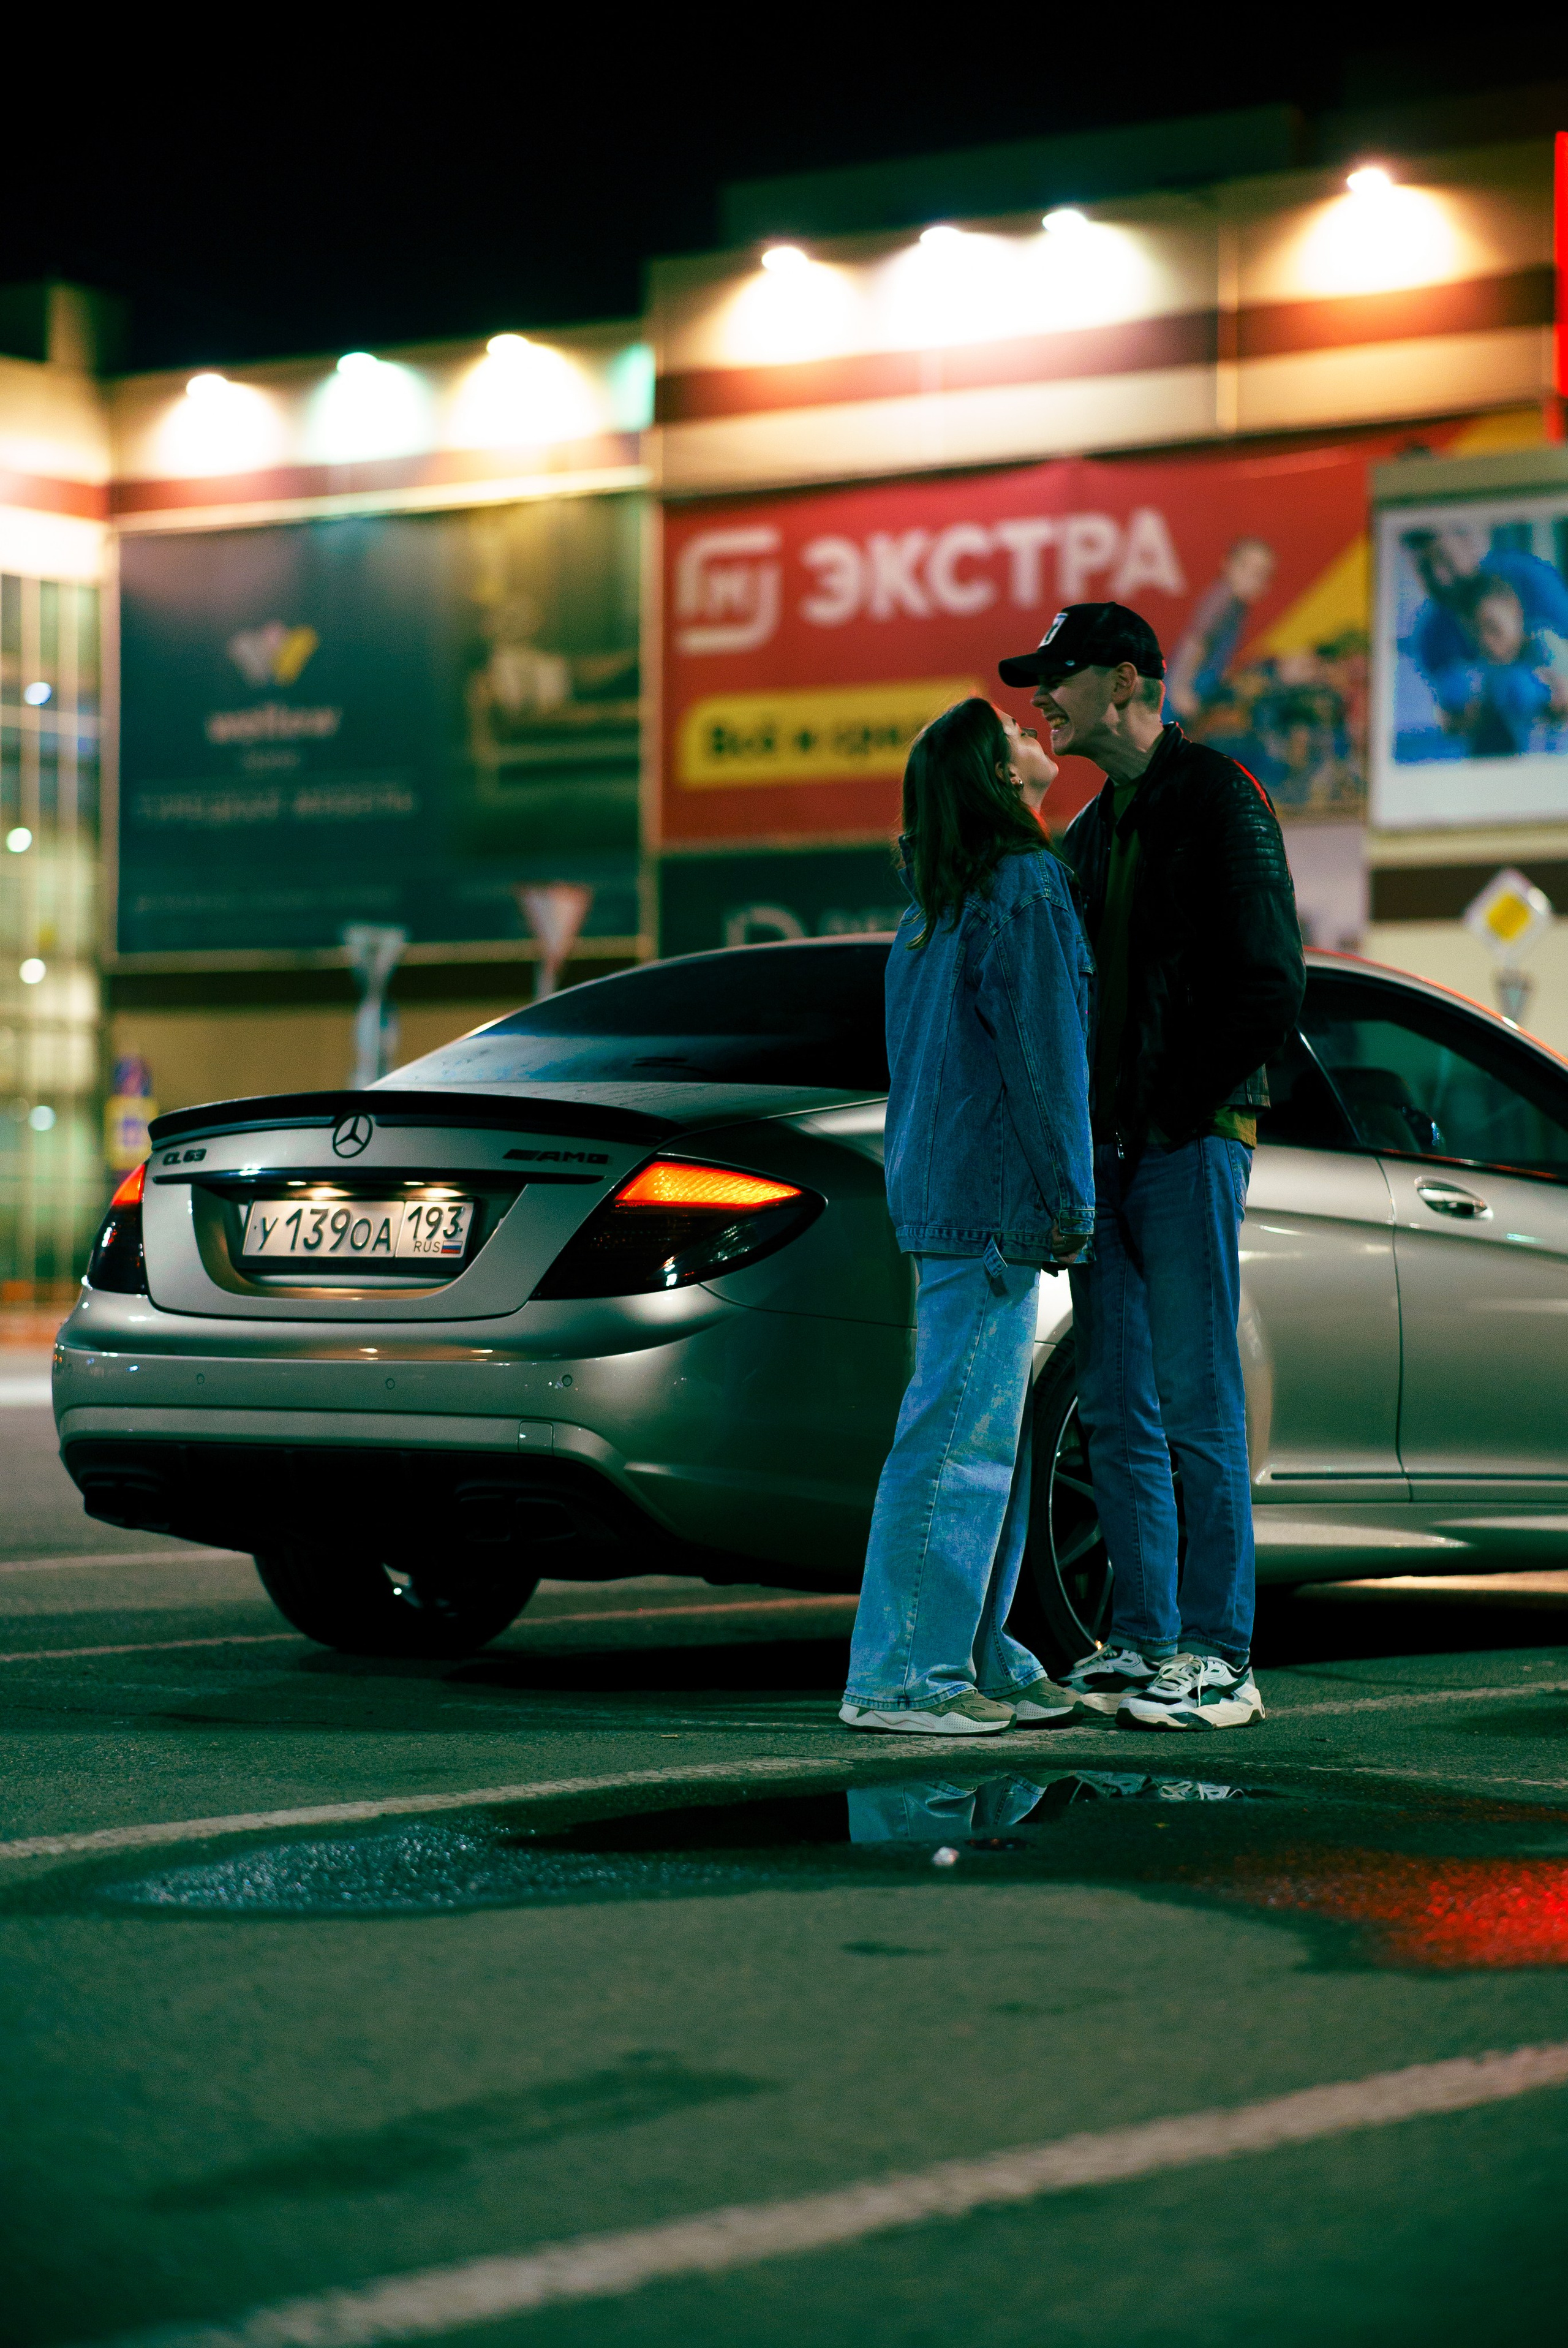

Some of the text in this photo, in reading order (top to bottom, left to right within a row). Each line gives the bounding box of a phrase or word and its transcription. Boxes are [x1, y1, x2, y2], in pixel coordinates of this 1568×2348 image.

[800, 507, 1186, 627] ЭКСТРА
[183, 1149, 206, 1163] 63
[407, 1206, 464, 1240] 193
[413, 1241, 440, 1253] RUS
